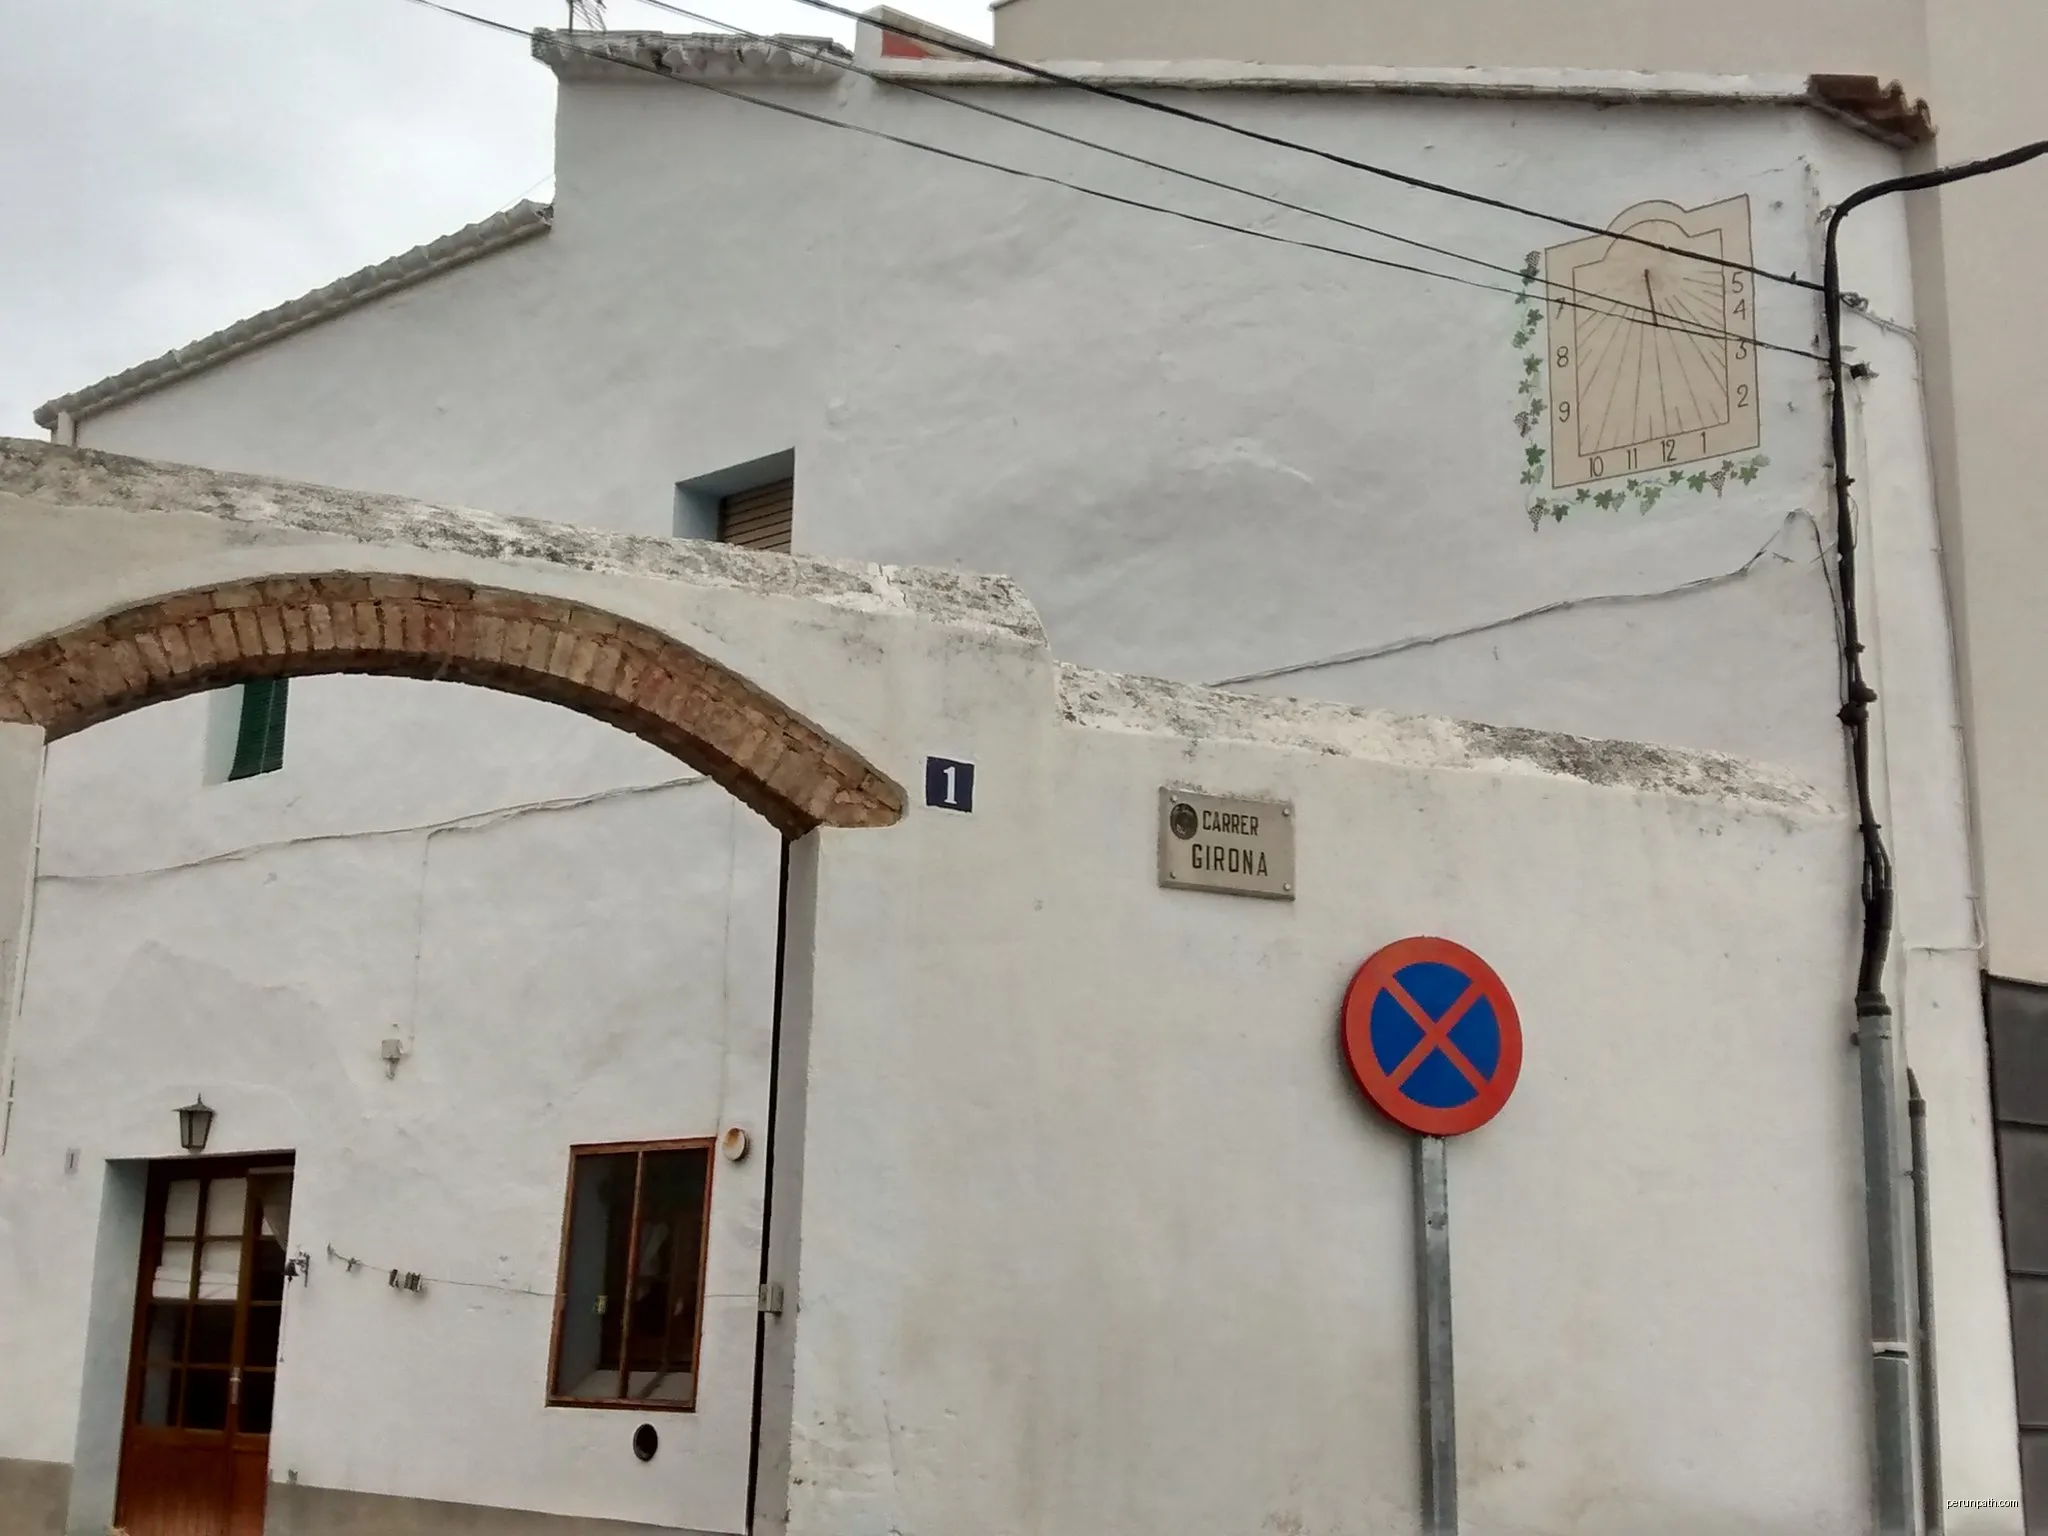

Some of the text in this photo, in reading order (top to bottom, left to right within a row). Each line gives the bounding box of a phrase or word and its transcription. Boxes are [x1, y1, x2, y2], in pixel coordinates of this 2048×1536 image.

[1731, 271, 1744, 293] 5
[1732, 298, 1746, 320] 4
[1556, 345, 1569, 368] 8
[1736, 384, 1749, 408] 2
[1559, 401, 1570, 423] 9
[1588, 455, 1604, 478] 10
[1661, 438, 1677, 462] 12
[943, 766, 957, 805] 1
[1202, 810, 1259, 836] CARRER
[1192, 843, 1268, 877] GIRONA
